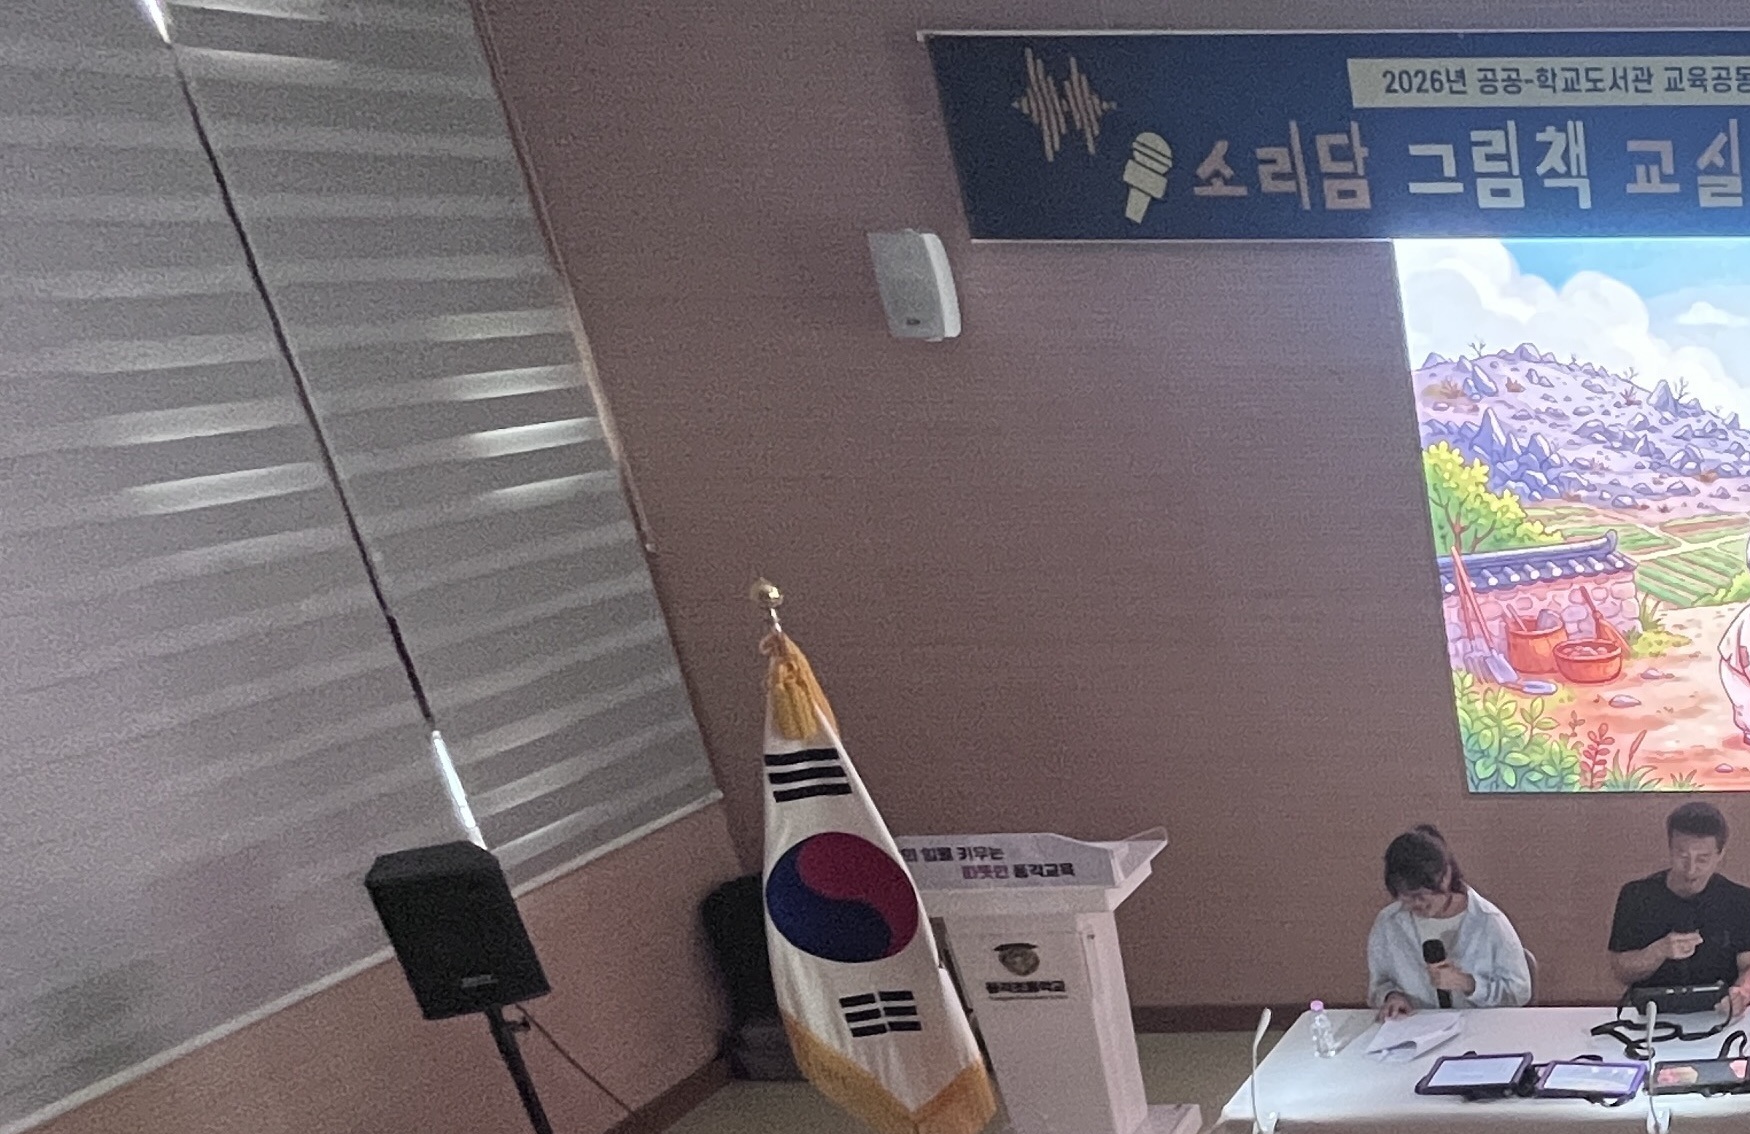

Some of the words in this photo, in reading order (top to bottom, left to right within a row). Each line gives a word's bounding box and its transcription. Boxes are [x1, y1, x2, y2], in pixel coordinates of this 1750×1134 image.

[1382, 67, 1468, 96] 2026년
[1476, 66, 1654, 96] 공공-학교도서관
[1192, 119, 1373, 211] 소리담
[1407, 119, 1593, 210] 그림책
[1625, 117, 1744, 208] 교실
[956, 846, 1004, 861] 키우는
